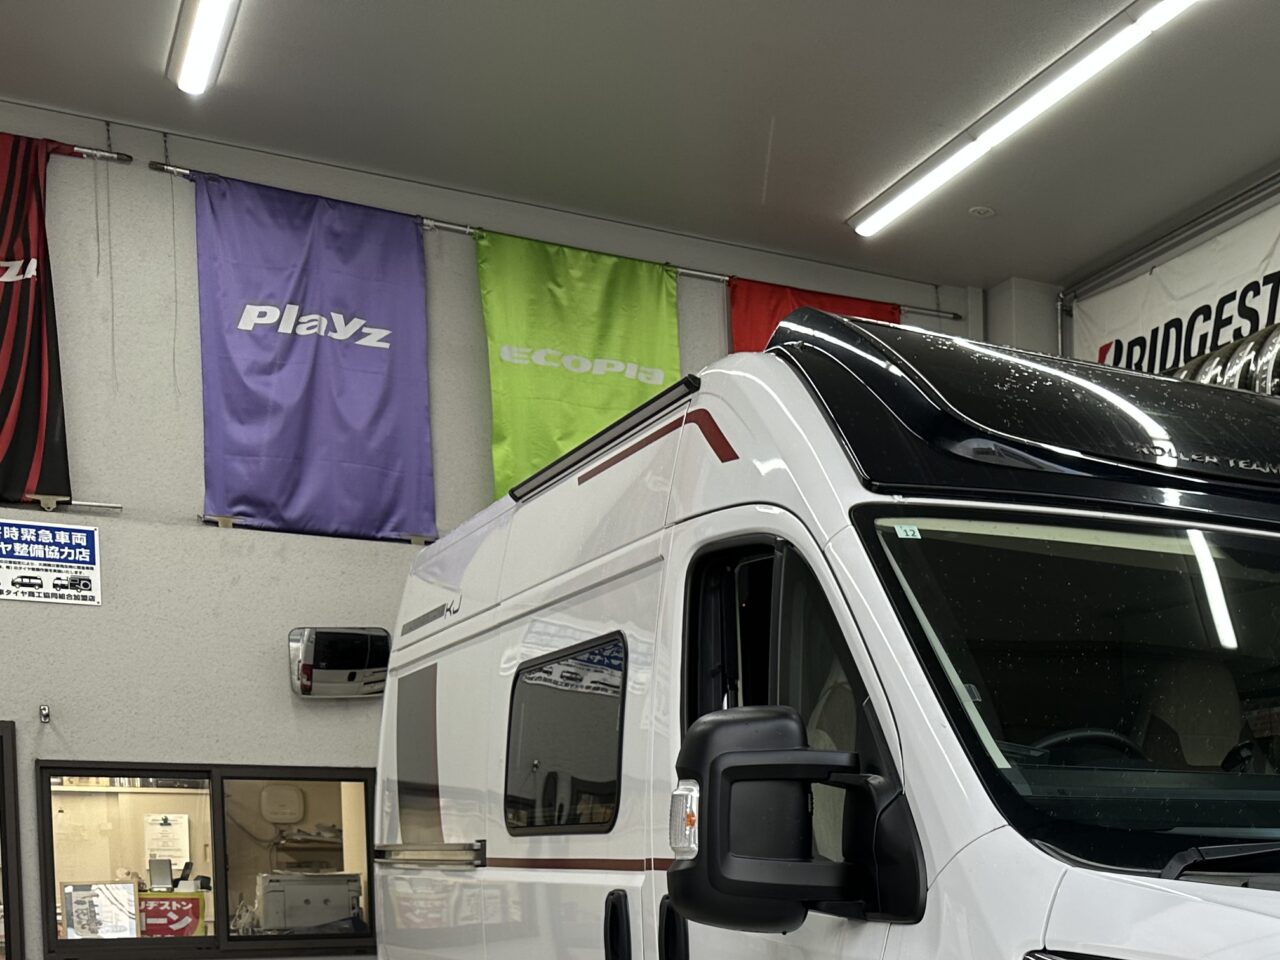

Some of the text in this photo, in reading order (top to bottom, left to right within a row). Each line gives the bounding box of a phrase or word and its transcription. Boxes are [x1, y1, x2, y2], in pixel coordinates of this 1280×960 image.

[237, 304, 392, 349] Playz
[0, 526, 87, 546] 時緊急車両
[903, 529, 917, 537] 12
[140, 911, 193, 931] ーン
